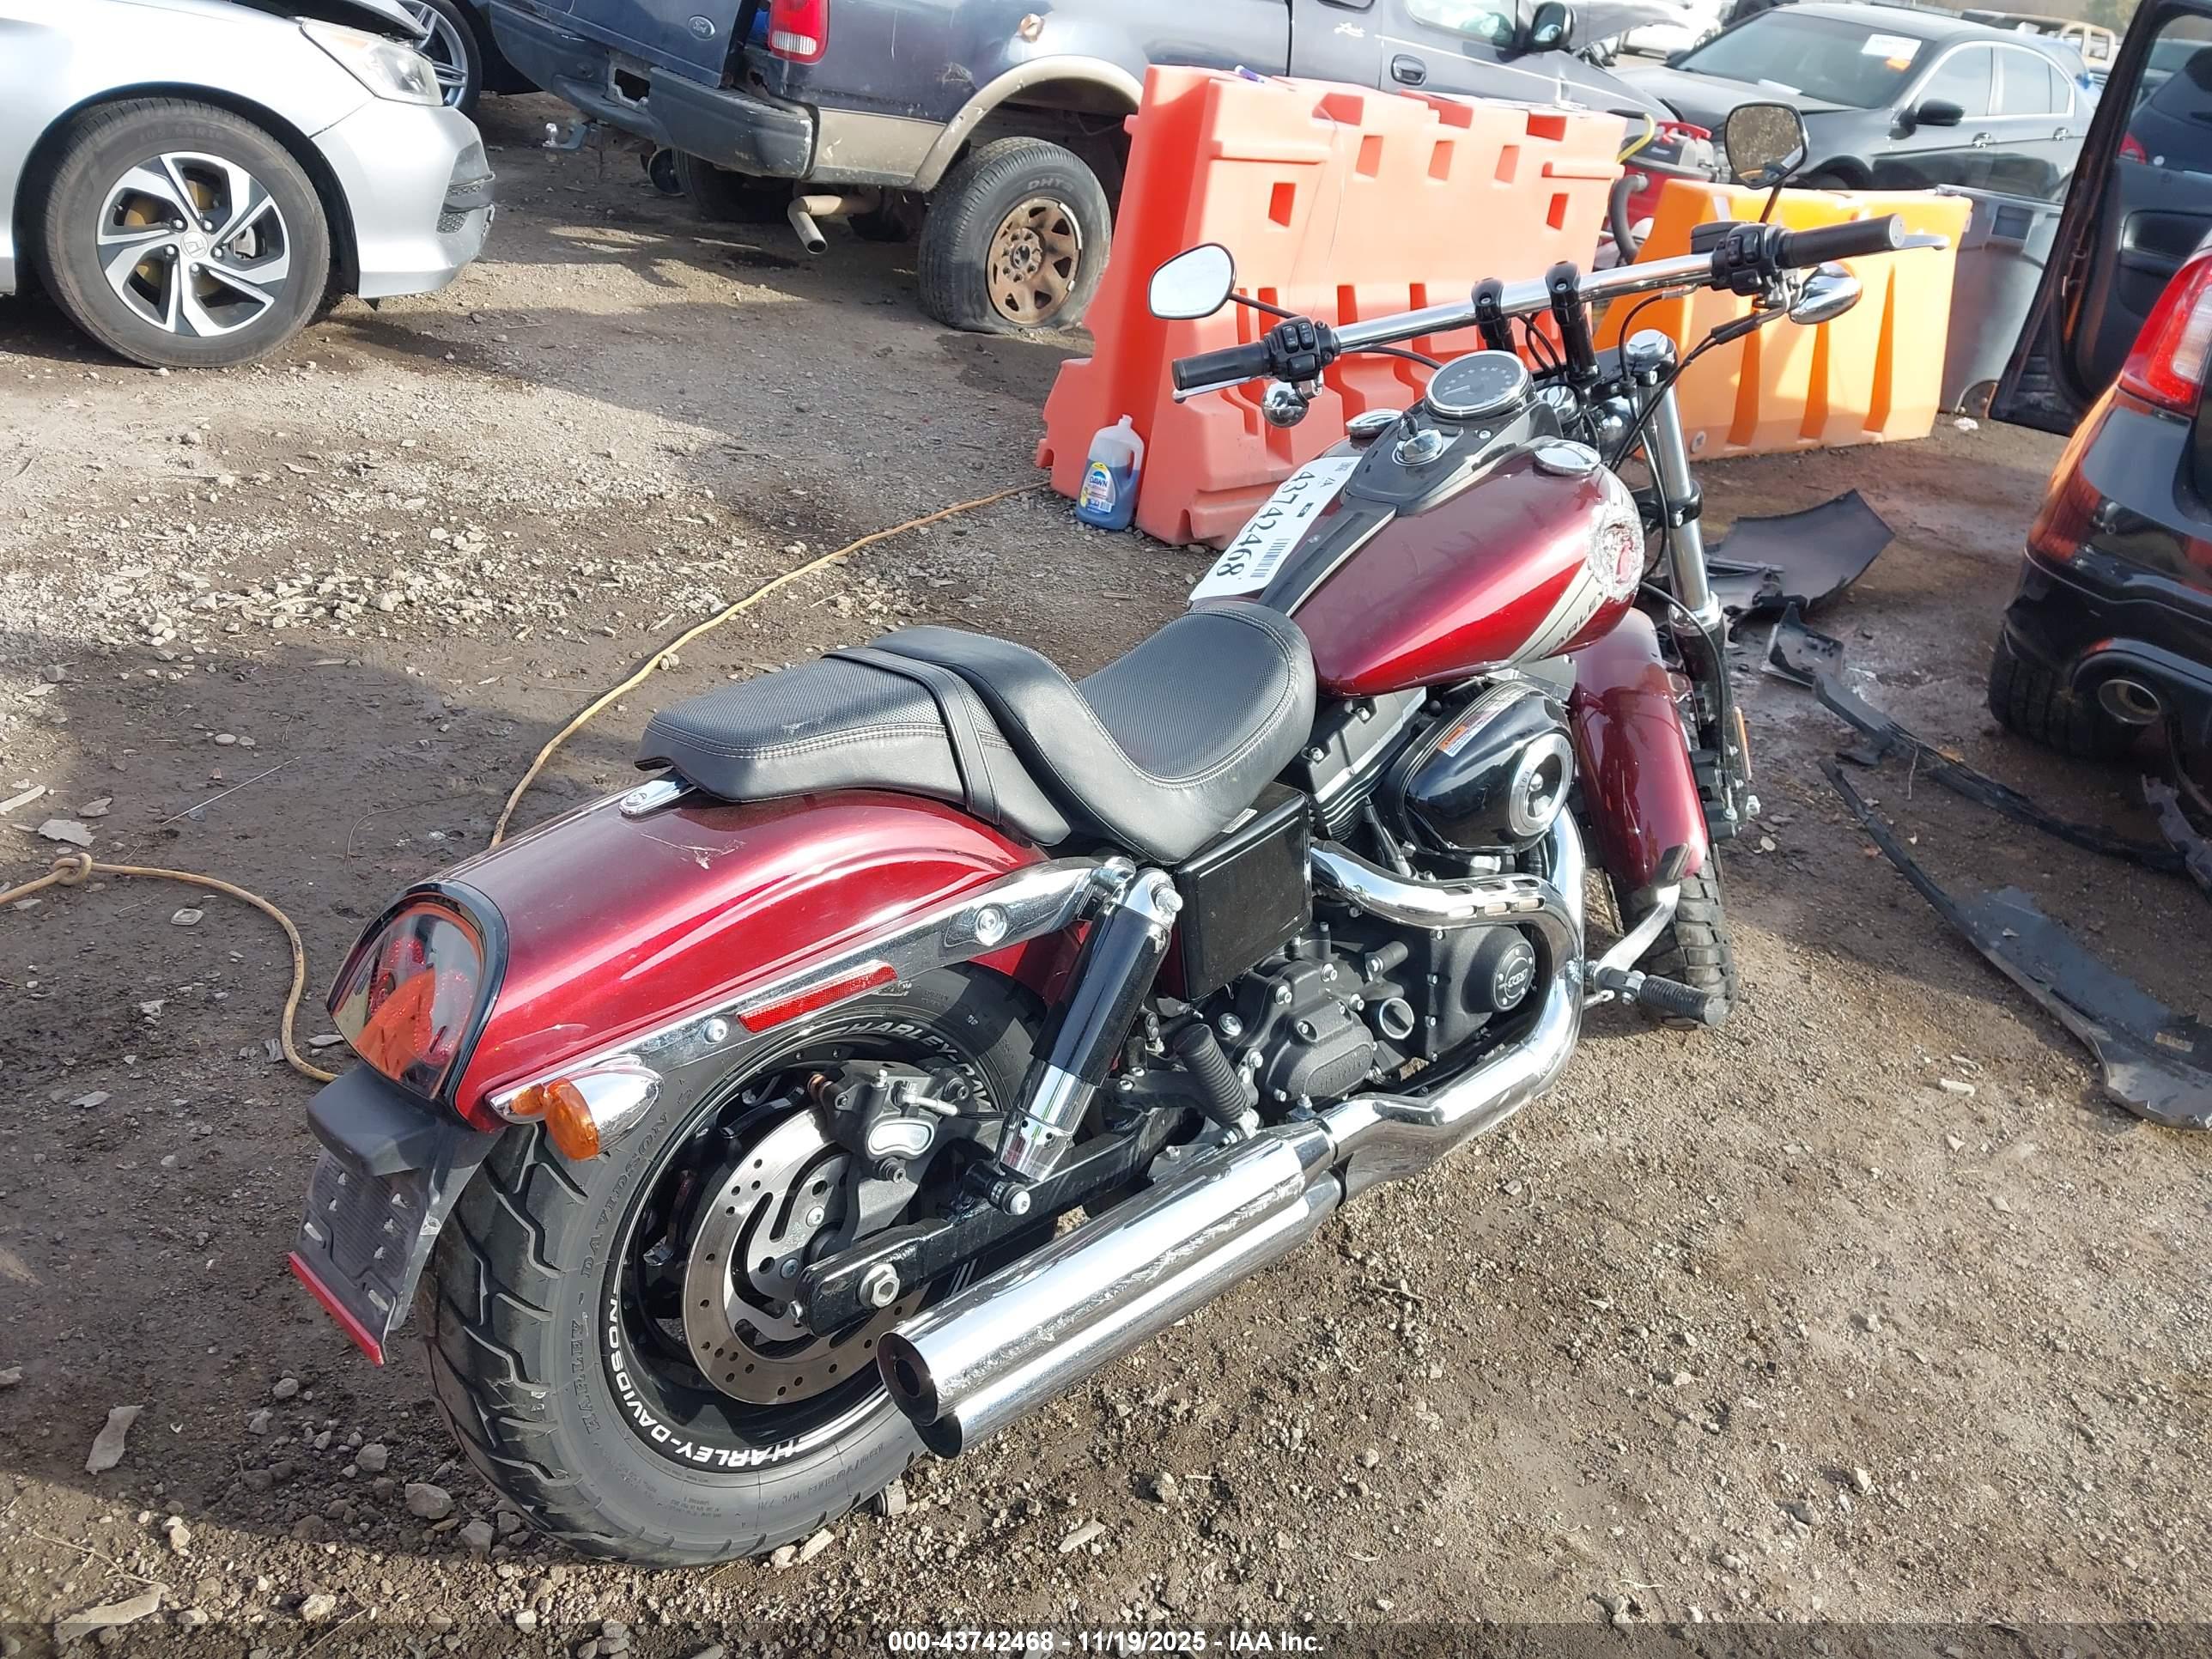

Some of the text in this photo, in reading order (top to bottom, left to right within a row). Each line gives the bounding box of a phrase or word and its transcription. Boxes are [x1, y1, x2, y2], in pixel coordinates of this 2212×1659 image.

[1090, 476, 1109, 488] DAWN
[1216, 471, 1316, 577] 43742468
[608, 1297, 795, 1468] HARLEY-DAVIDSON
